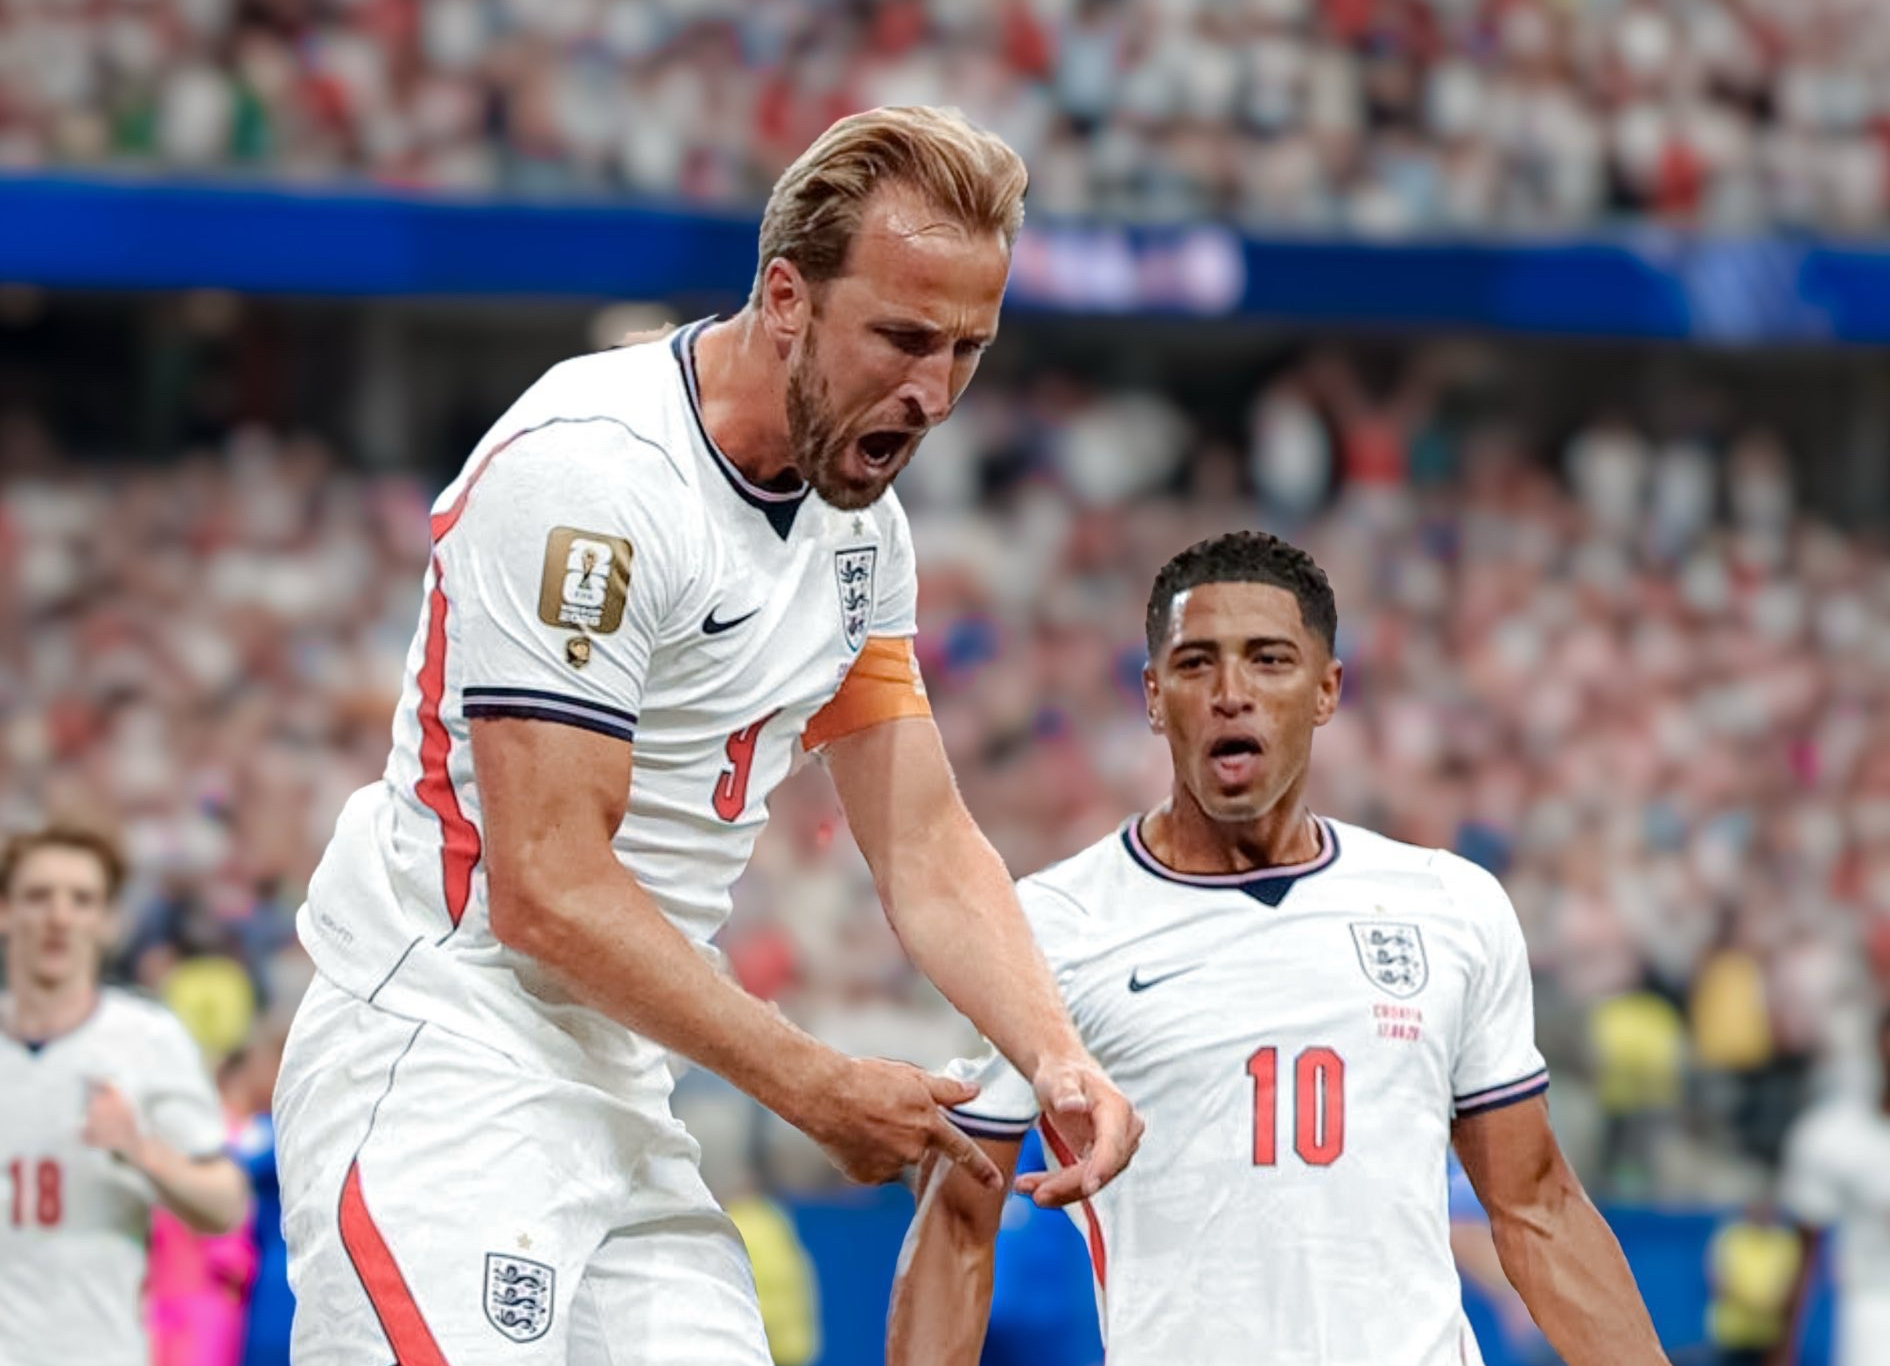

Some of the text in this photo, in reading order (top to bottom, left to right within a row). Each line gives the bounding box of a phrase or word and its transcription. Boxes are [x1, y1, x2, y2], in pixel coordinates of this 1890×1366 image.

[712, 707, 785, 822] 9
[1246, 1046, 1345, 1166] 10
[8, 1154, 64, 1229] 18
